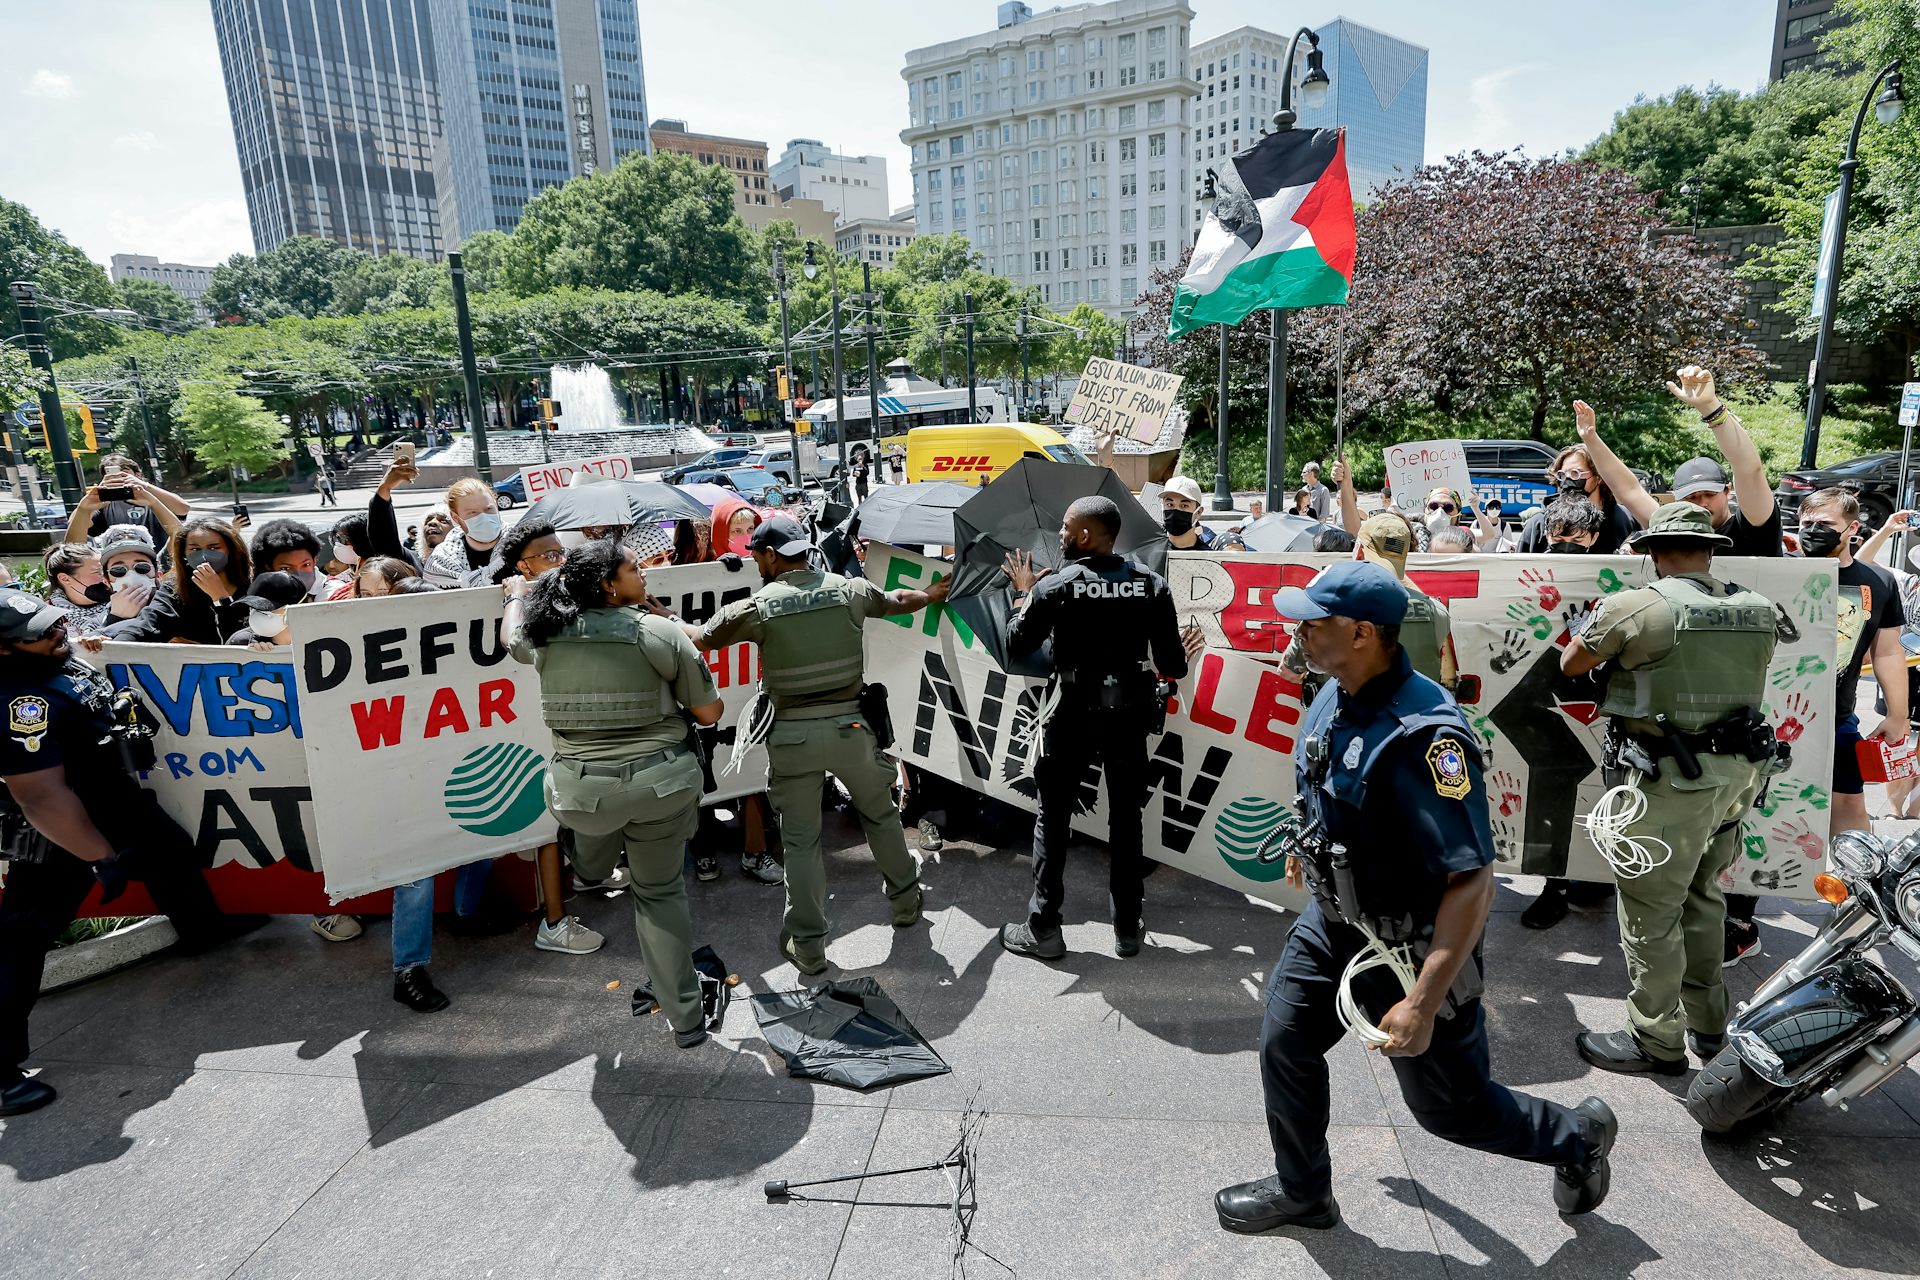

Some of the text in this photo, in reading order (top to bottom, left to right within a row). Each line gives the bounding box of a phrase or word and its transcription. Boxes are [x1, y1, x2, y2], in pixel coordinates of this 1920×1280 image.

[1086, 359, 1175, 392] GSU ALUM SAY:
[1078, 379, 1166, 419] DIVEST FROM
[1082, 402, 1136, 438] DEATH
[932, 456, 994, 471] DHL
[1390, 448, 1464, 469] Genocide
[527, 467, 574, 492] END
[1424, 466, 1451, 481] NOT
[1073, 581, 1146, 598] POLICE
[350, 678, 518, 751] WAR
